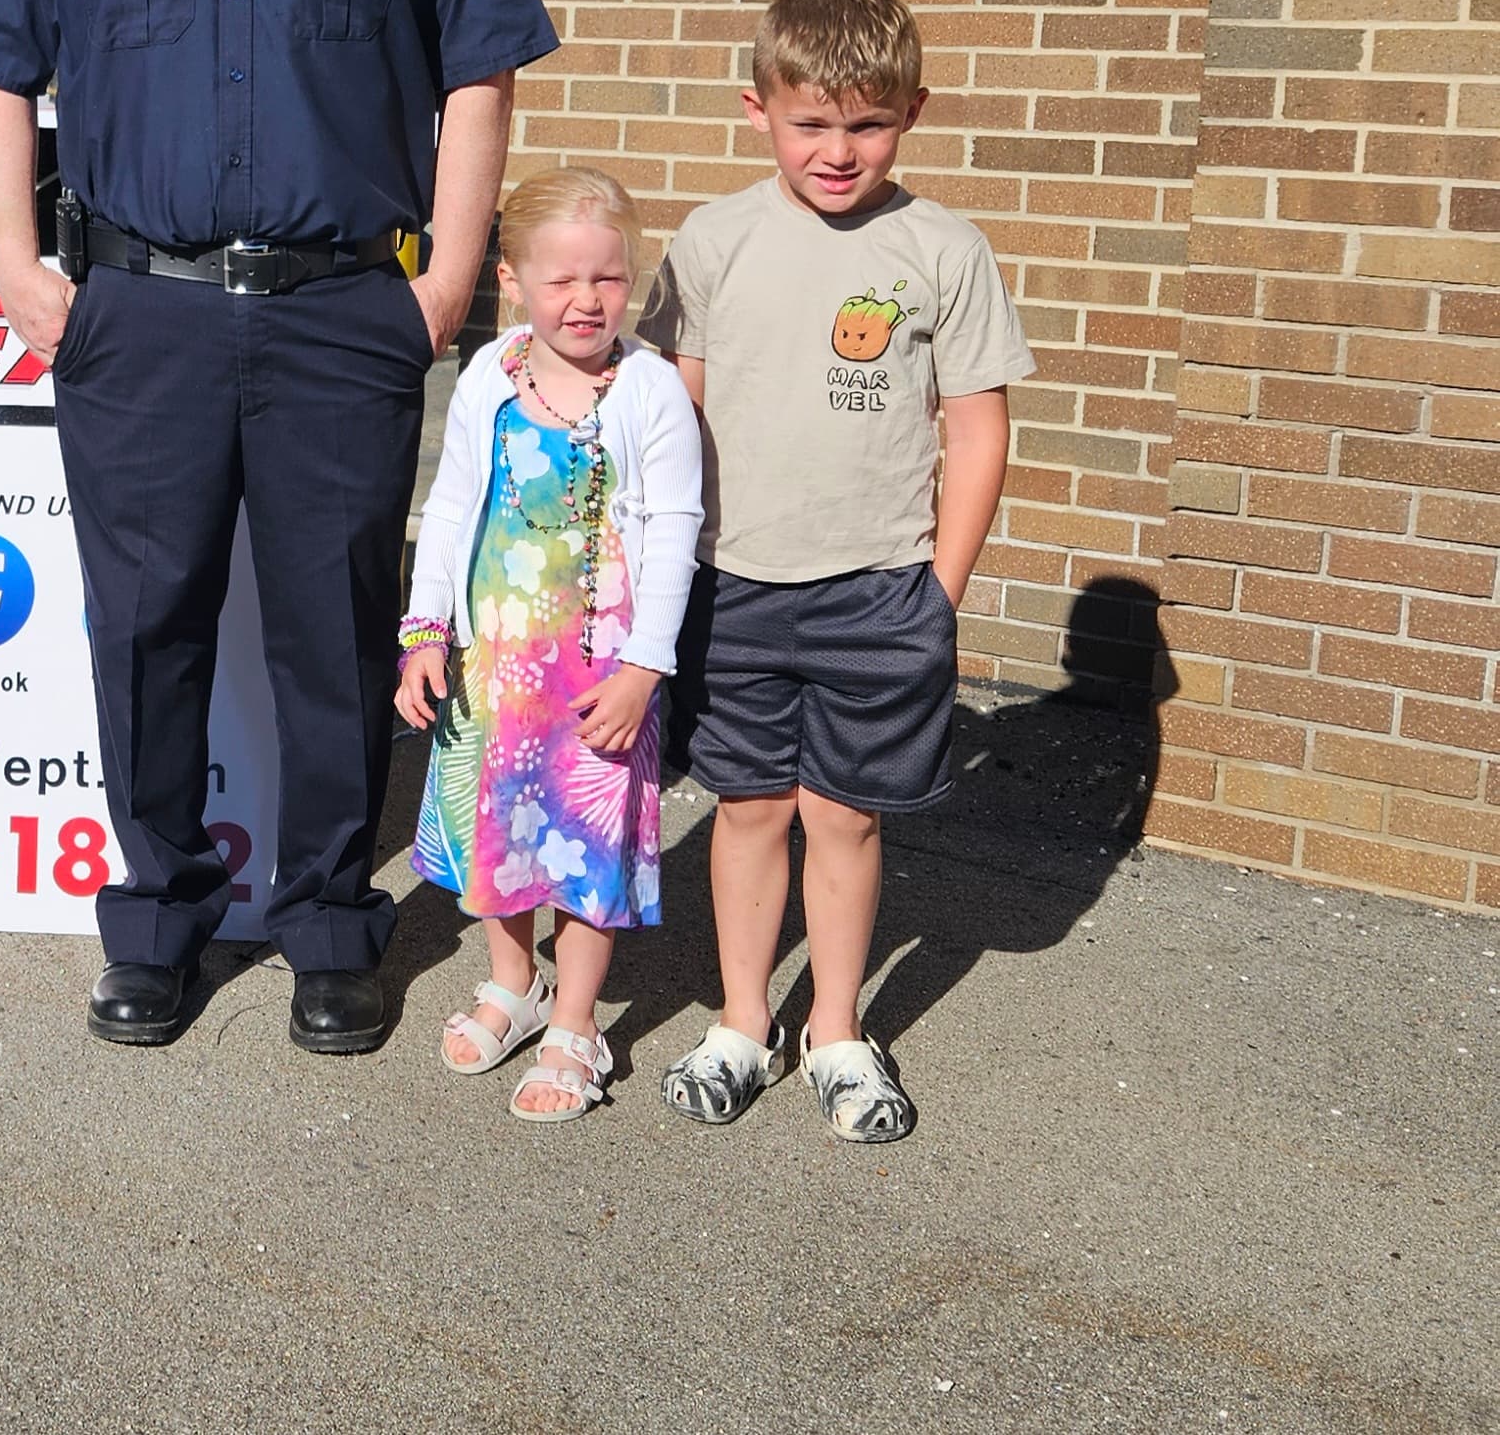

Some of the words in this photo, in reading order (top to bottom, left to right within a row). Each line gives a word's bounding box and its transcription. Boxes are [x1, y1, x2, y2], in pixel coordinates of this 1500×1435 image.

[827, 367, 890, 390] MAR
[829, 391, 886, 412] VEL
[47, 496, 73, 516] U
